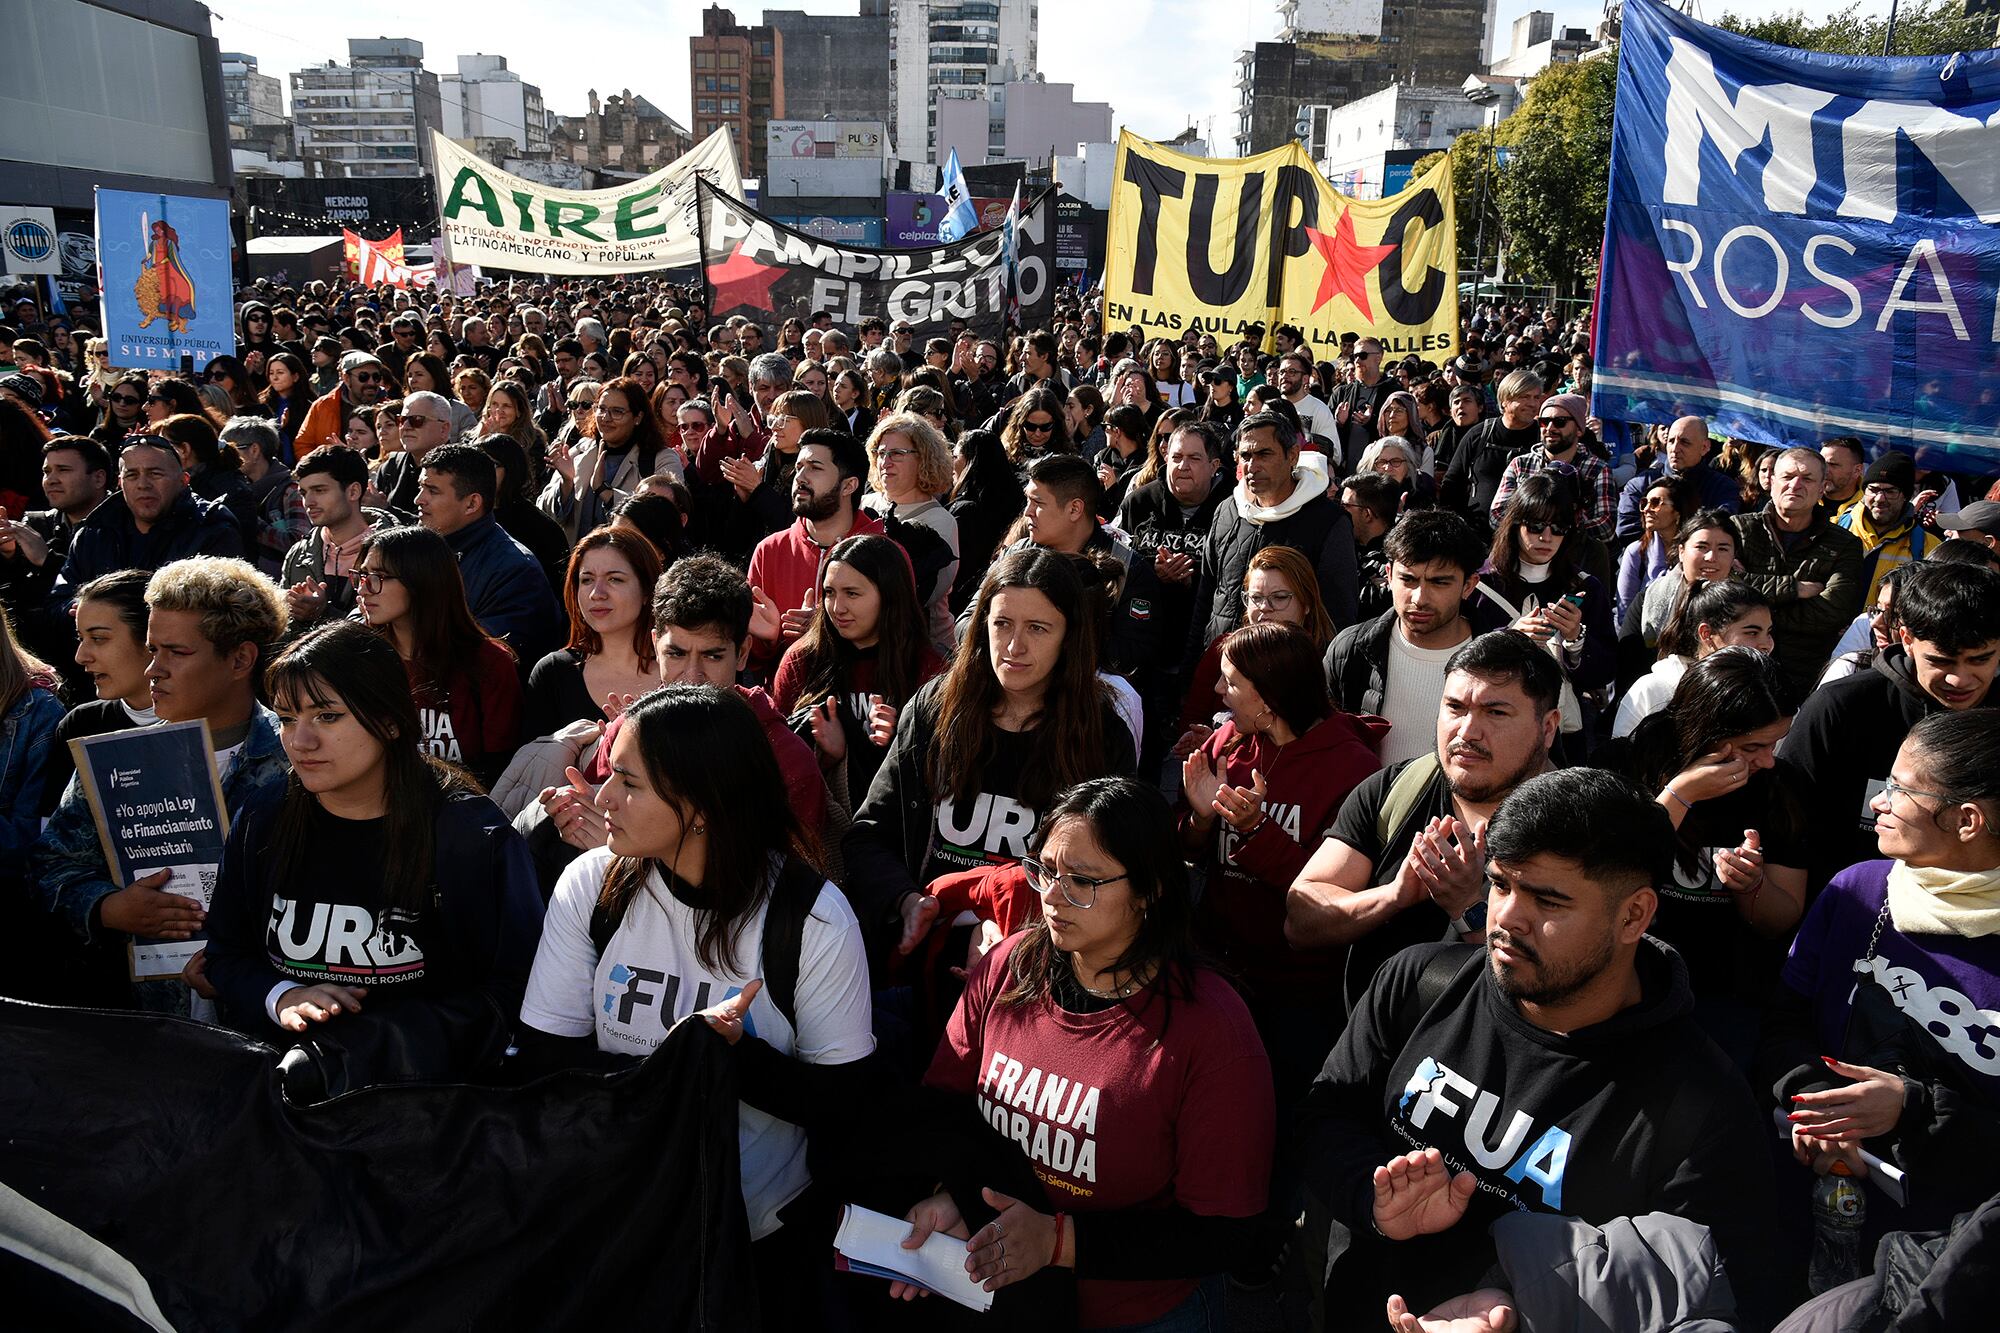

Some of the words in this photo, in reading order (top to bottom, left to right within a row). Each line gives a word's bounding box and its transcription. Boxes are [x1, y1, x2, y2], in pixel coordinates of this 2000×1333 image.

[1389, 170, 1412, 178] perso
[325, 196, 369, 207] MERCADO
[443, 166, 667, 242] AIRE
[327, 209, 369, 220] ZARPADO
[582, 251, 590, 262] Y
[599, 250, 657, 263] POPULAR
[811, 278, 872, 325] EL
[887, 255, 1047, 326] GRITO
[1662, 218, 2000, 343] ROSA
[1108, 302, 1133, 322] EN
[1141, 308, 1182, 331] LAS
[1312, 327, 1339, 347] LA
[1378, 333, 1451, 353] ALLES
[121, 334, 182, 347] UNIVERSIDAD
[184, 337, 221, 350] PÚBLICA
[136, 802, 164, 819] apoyo
[164, 797, 176, 812] la
[176, 796, 196, 814] Ley
[121, 824, 134, 840] de
[134, 816, 214, 839] Financiamiento
[1859, 822, 1876, 833] FED
[125, 838, 194, 860] Universitario
[1660, 888, 1684, 900] ACIÓN
[296, 970, 363, 985] UNIVERSITARIA
[364, 976, 378, 985] DE
[379, 970, 425, 985] ROSARIO
[602, 1022, 647, 1047] Federación
[983, 1050, 1101, 1136] FRANJA
[1404, 1060, 1573, 1211] FUA
[1047, 1174, 1094, 1198] Siempre
